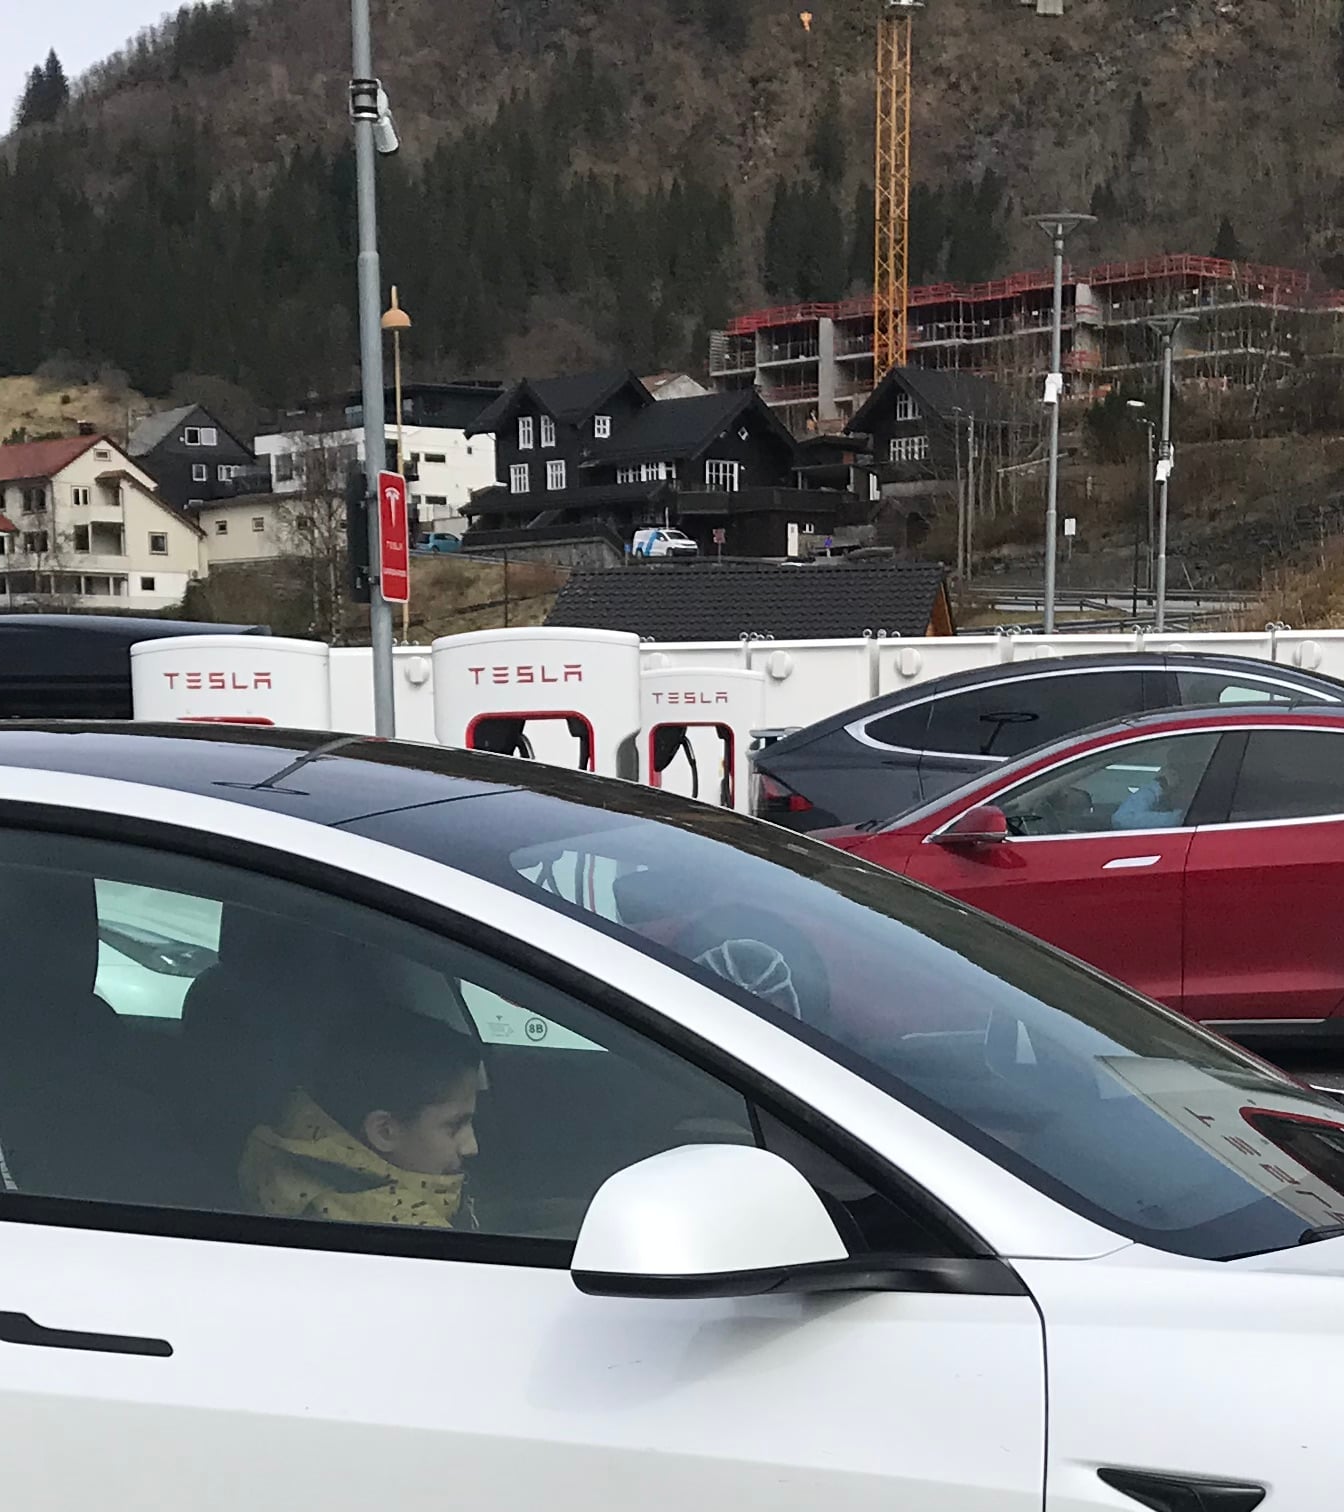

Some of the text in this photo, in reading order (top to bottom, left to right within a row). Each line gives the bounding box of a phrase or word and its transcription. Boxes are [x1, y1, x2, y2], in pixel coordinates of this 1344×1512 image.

[163, 672, 272, 690] TESLA
[468, 664, 583, 685] TESLA
[652, 692, 728, 704] TESLA
